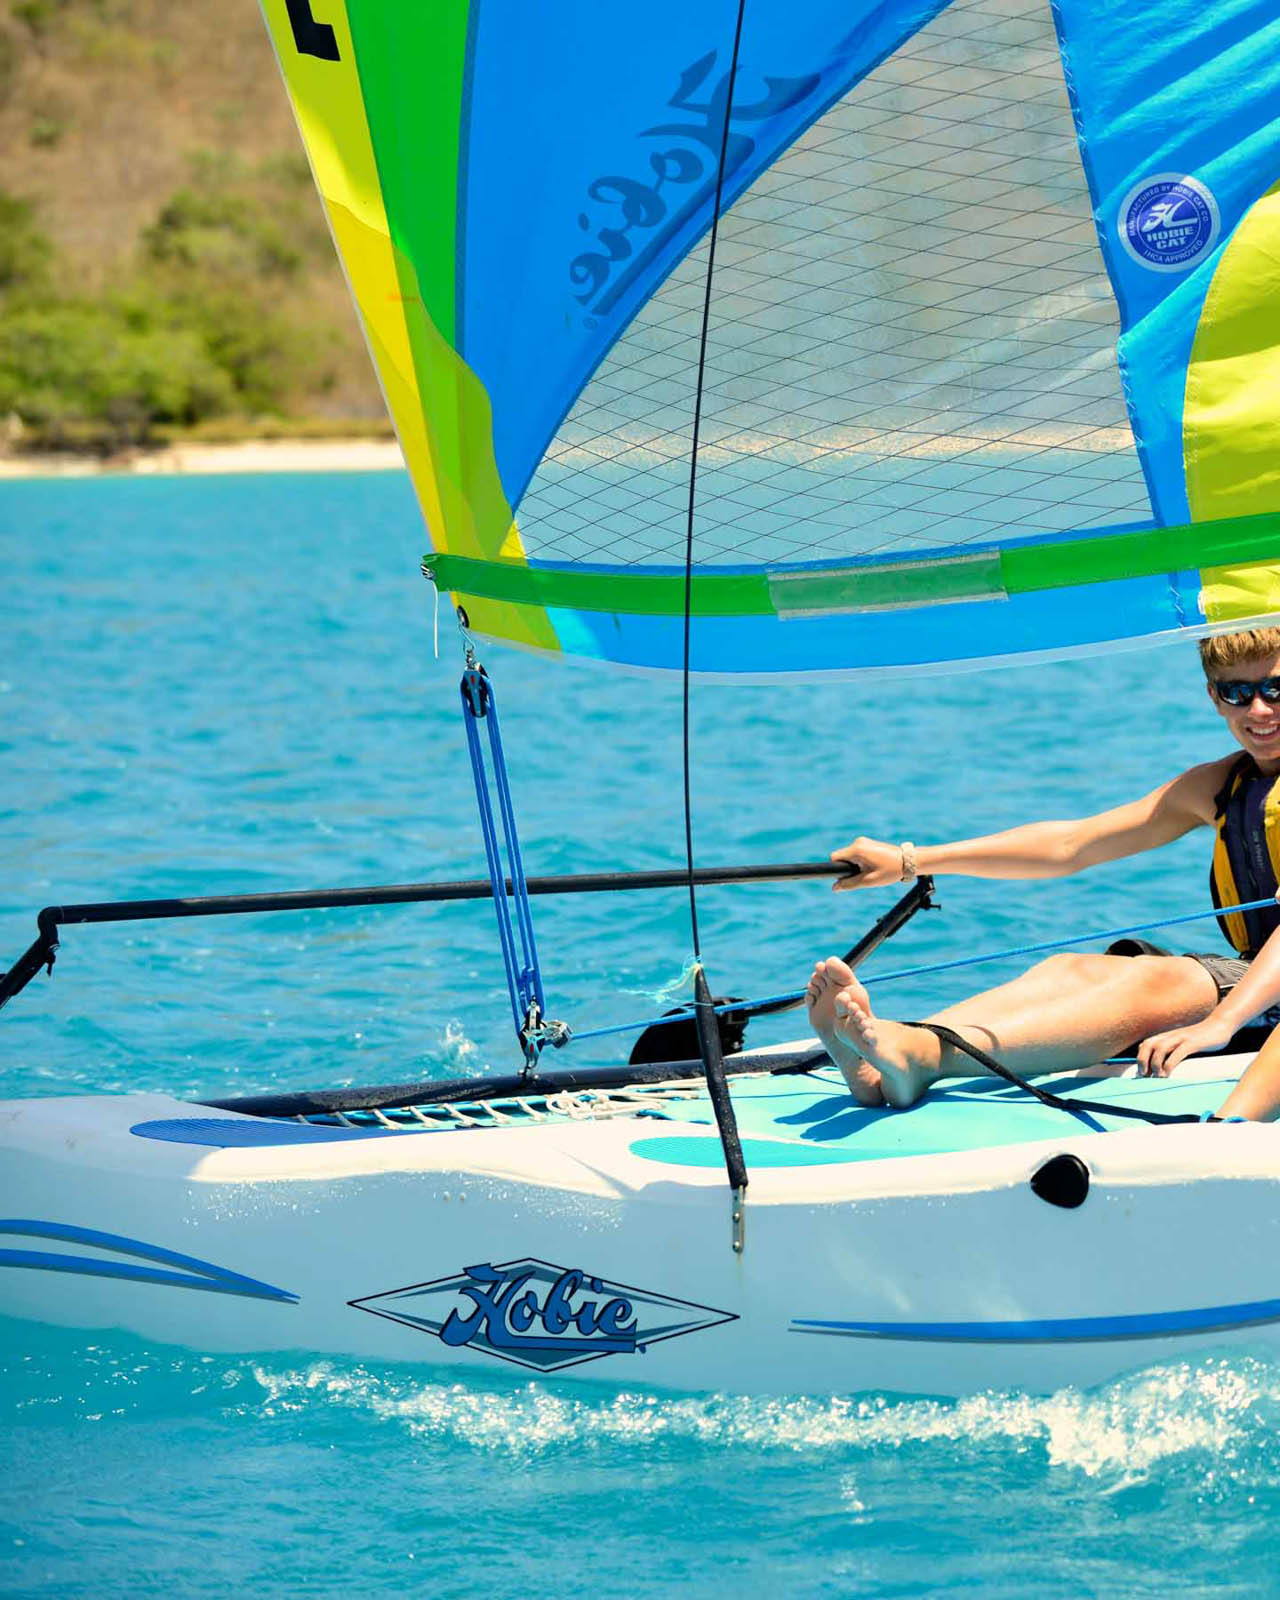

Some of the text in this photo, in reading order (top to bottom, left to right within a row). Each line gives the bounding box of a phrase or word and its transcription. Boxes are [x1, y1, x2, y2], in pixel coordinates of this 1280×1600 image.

[1129, 187, 1160, 236] MANUFACTURED
[1172, 186, 1194, 197] HOBIE
[1194, 197, 1206, 210] CAT
[1147, 227, 1194, 242] HOBIE
[1156, 237, 1186, 249] CAT
[1164, 240, 1203, 262] APPROVED
[439, 1263, 638, 1353] Hobie
